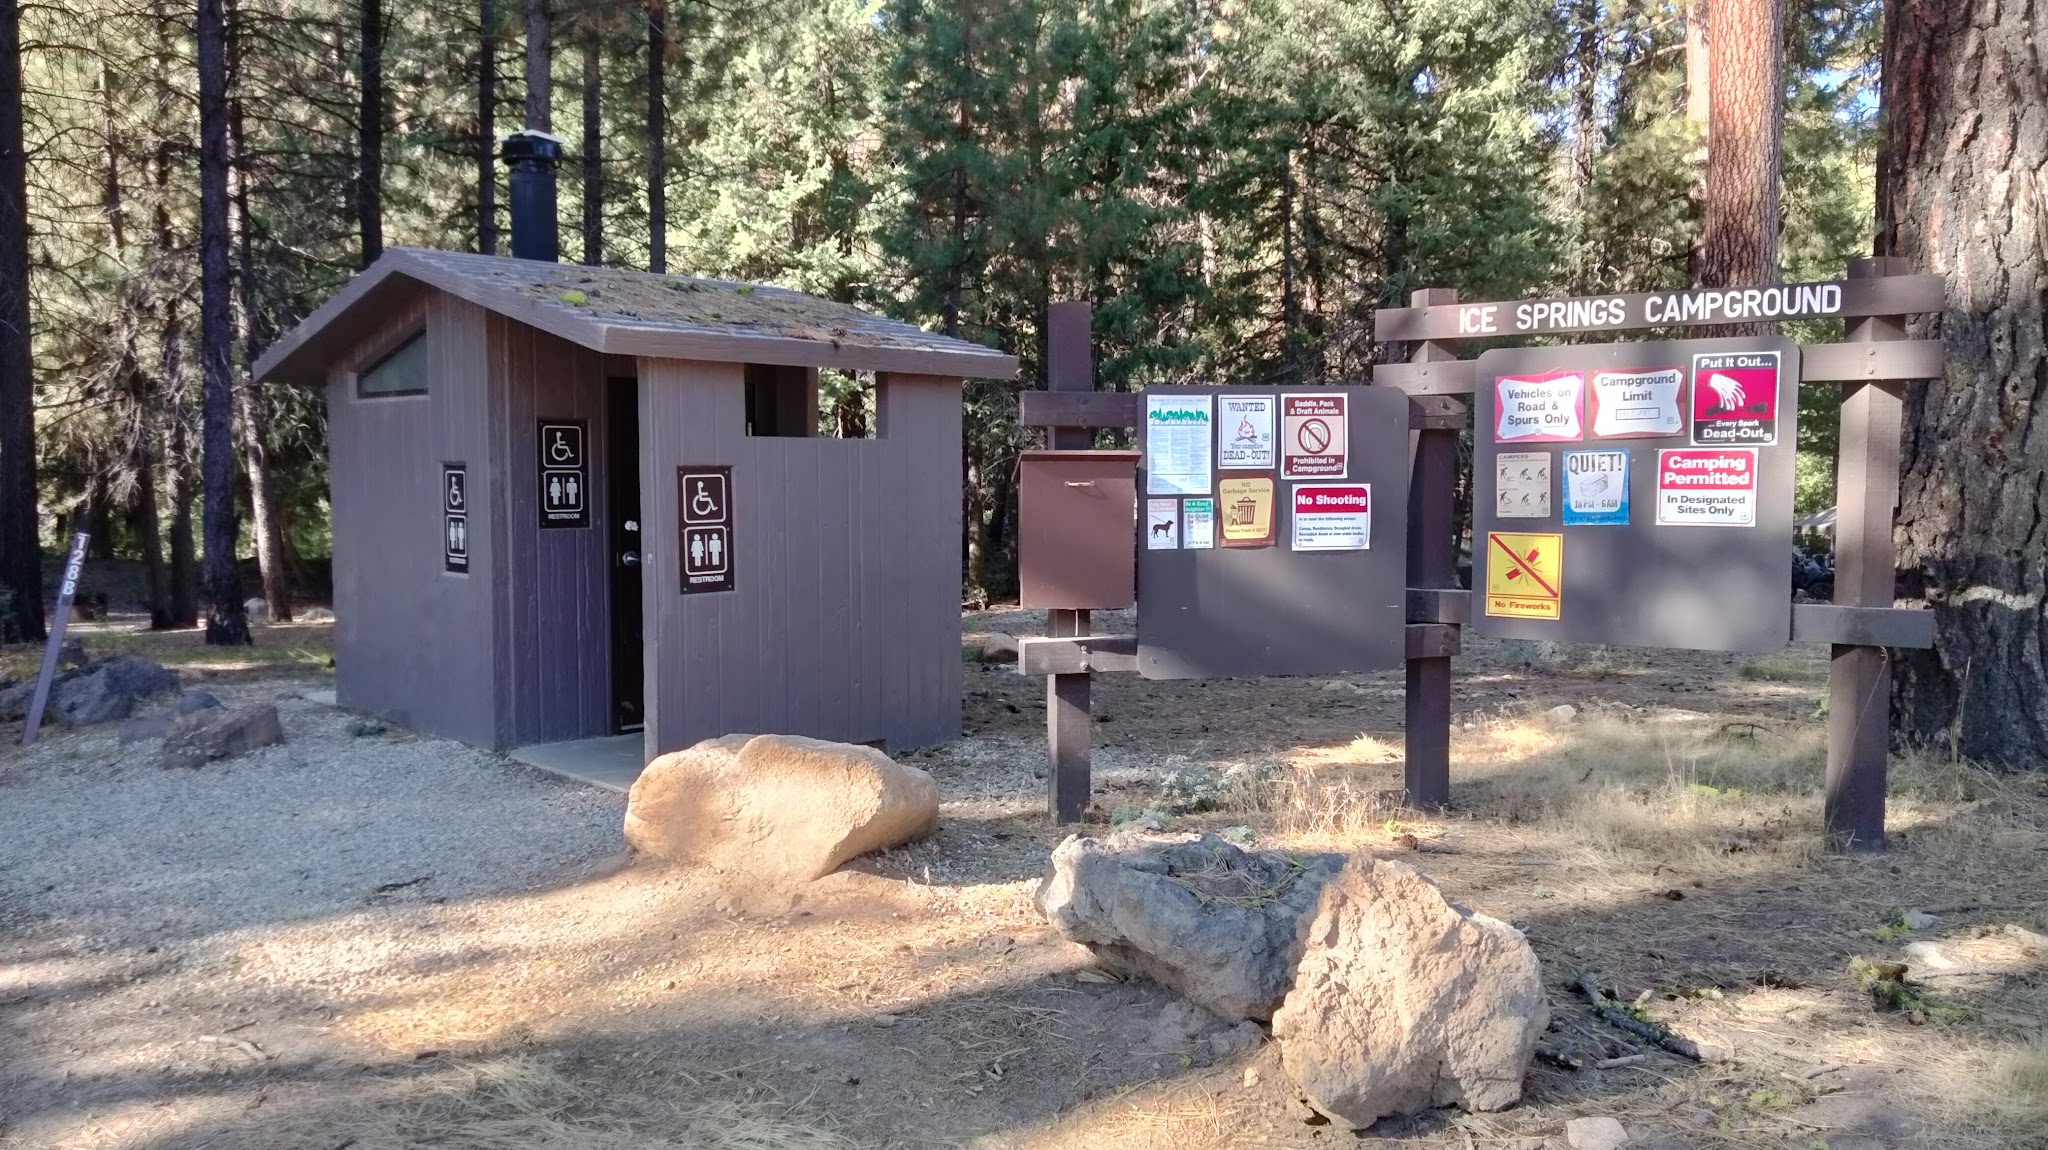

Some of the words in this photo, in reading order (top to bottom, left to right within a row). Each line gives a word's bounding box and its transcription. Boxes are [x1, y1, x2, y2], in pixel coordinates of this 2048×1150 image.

[1459, 306, 1498, 334] ICE
[1516, 298, 1626, 330] SPRINGS
[1645, 284, 1842, 323] CAMPGROUND
[1701, 358, 1723, 368] Put
[1726, 358, 1734, 367] It
[1737, 357, 1772, 367] Out...
[1601, 373, 1676, 387] Campground
[1508, 388, 1552, 399] Vehicles
[1622, 391, 1652, 401] Limit
[1228, 402, 1266, 412] WANTED
[1294, 400, 1318, 408] Saddle,
[1518, 401, 1545, 412] Road
[1551, 401, 1559, 410] &
[1508, 415, 1539, 426] Spurs
[1544, 414, 1570, 425] Only
[1242, 443, 1263, 451] campfire
[1292, 464, 1337, 473] Campground
[1568, 453, 1622, 475] QUIET!
[1669, 455, 1746, 471] Camping
[1663, 471, 1750, 485] Permitted
[1297, 495, 1313, 505] No
[1315, 494, 1366, 506] Shooting
[1667, 495, 1678, 503] In
[1680, 495, 1745, 505] Designated
[1677, 505, 1706, 514] Sites
[1708, 506, 1734, 516] Only
[690, 575, 724, 584] RESTROOM
[1495, 600, 1506, 608] No
[1509, 601, 1551, 610] Fireworks
